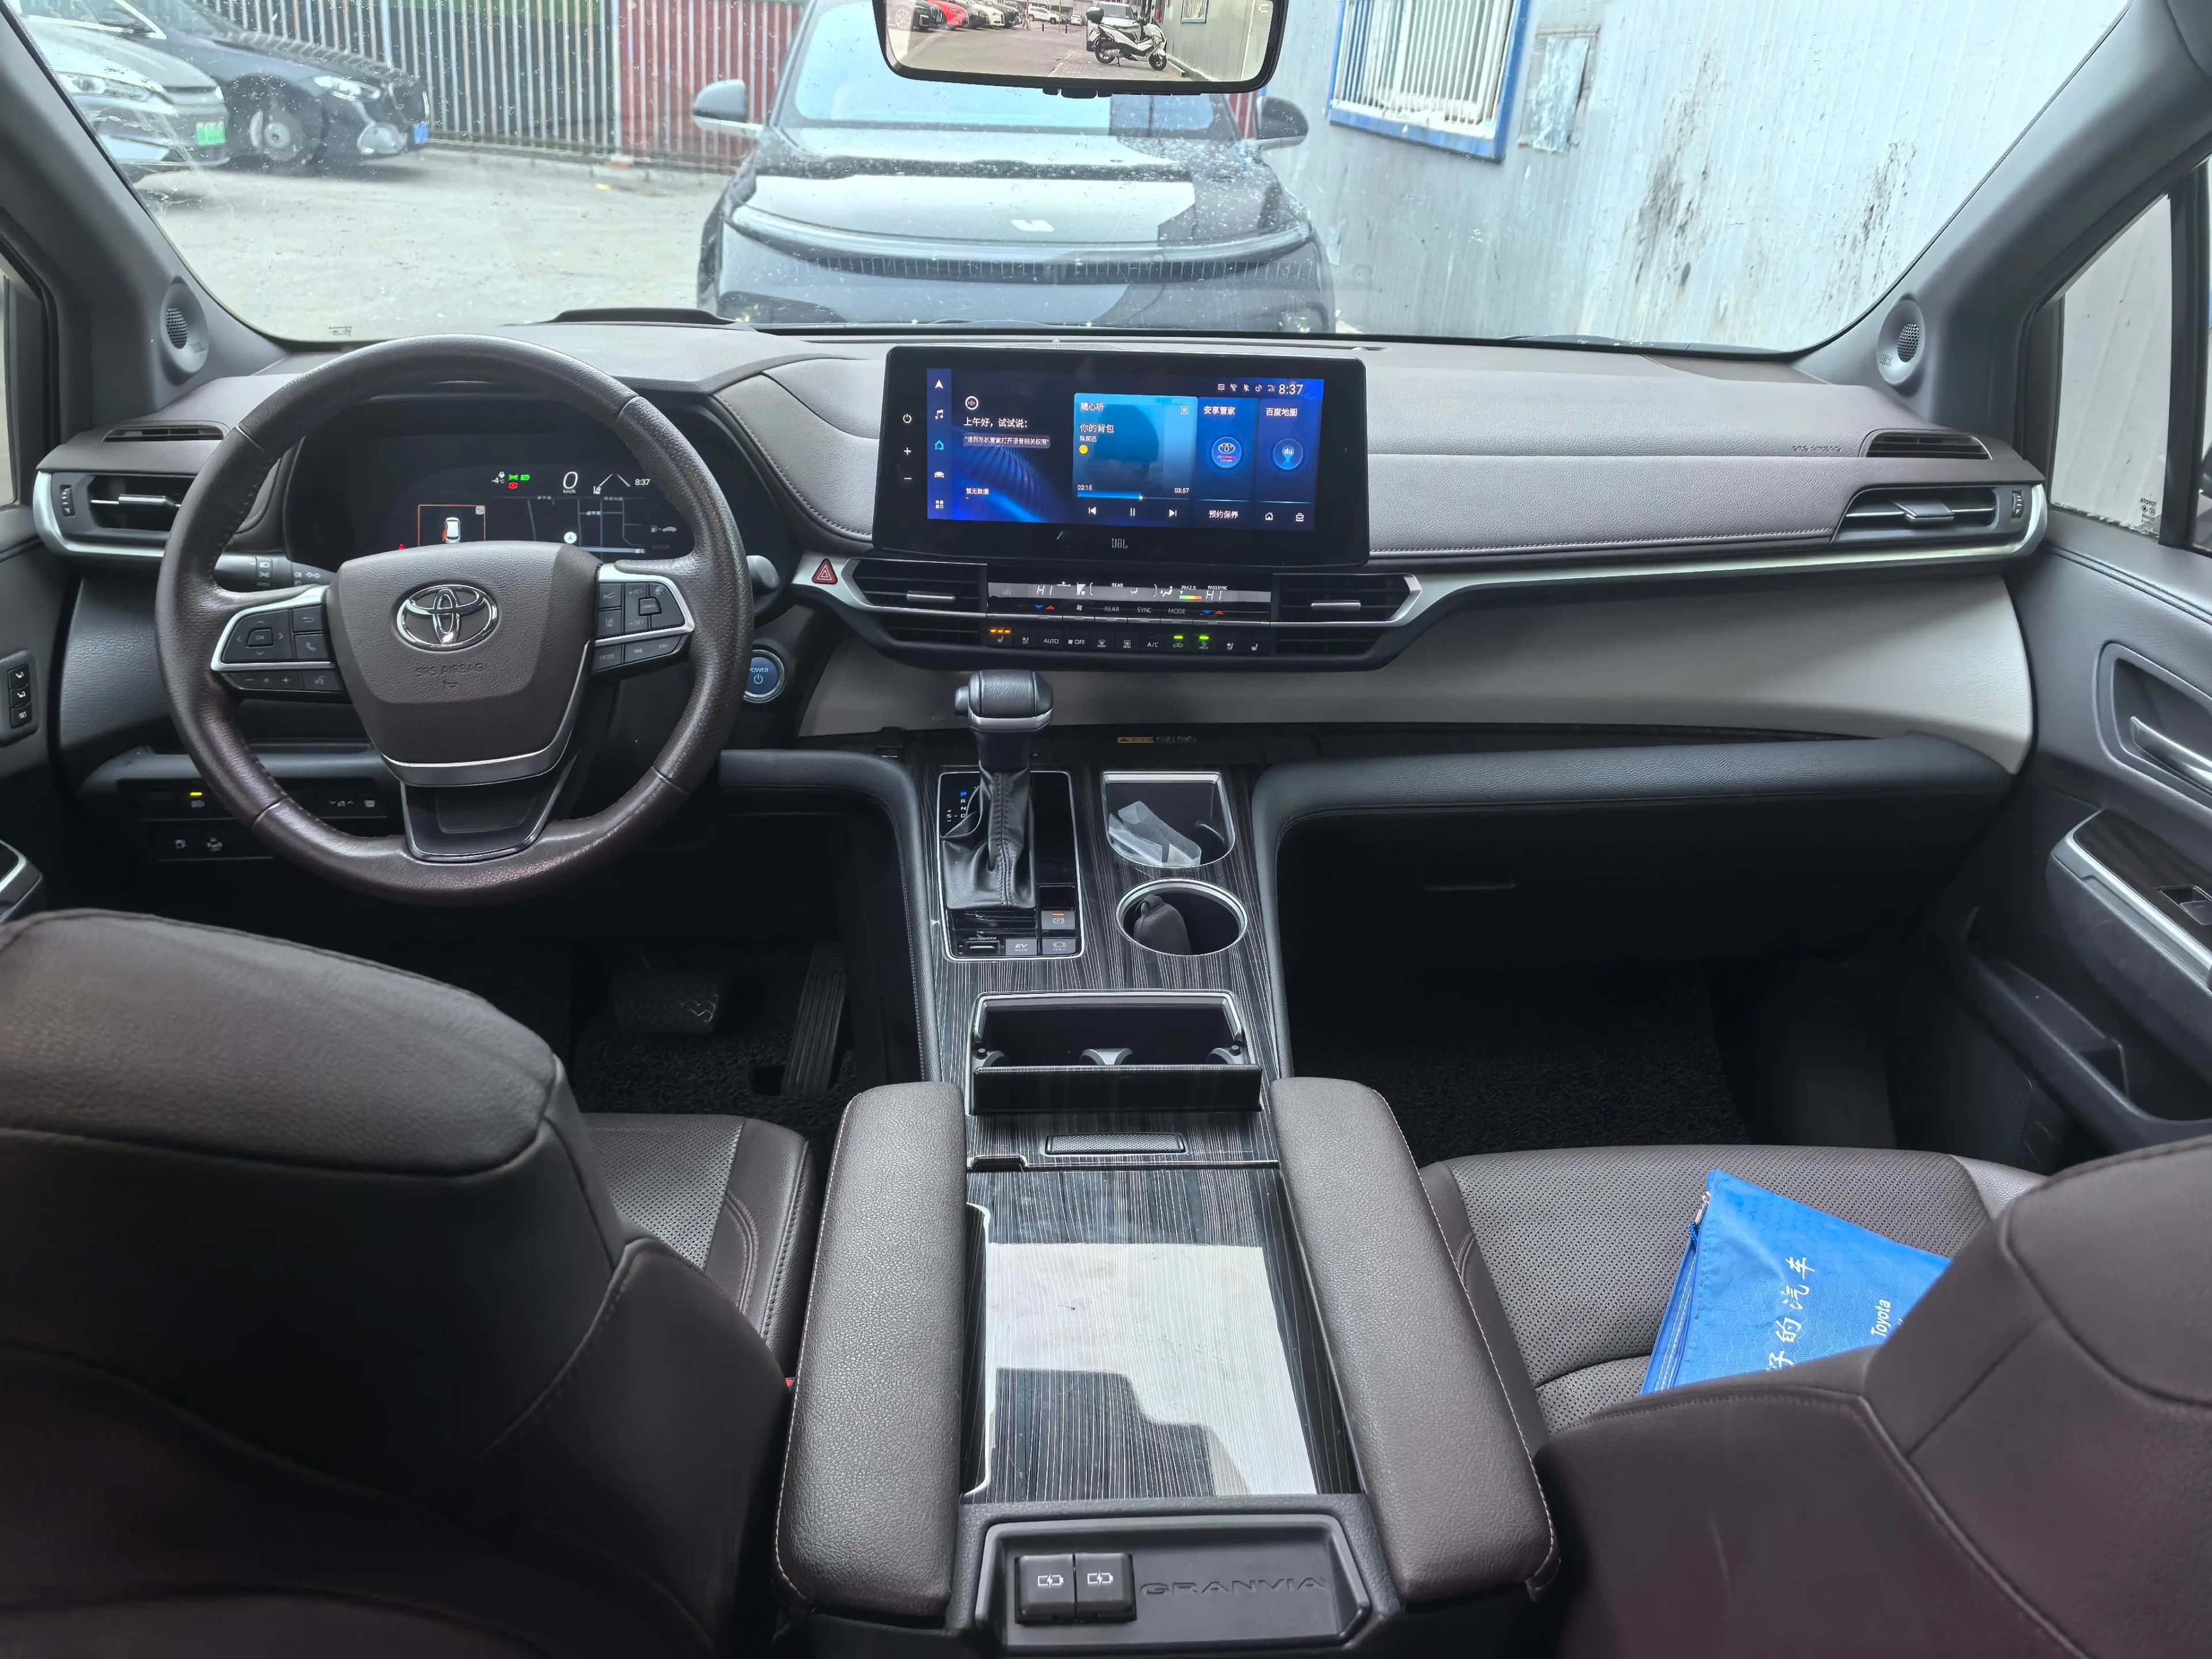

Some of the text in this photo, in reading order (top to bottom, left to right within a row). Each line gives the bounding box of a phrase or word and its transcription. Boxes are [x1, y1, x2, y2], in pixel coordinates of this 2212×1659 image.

[1278, 384, 1304, 395] 8:37
[1080, 402, 1104, 411] 随心听
[1203, 406, 1236, 415] 安享管家
[1266, 407, 1298, 417] 百度地图
[1080, 423, 1114, 433] 你的背包
[562, 471, 578, 489] 0
[1209, 510, 1239, 519] 预约保养
[1111, 538, 1128, 549] JBL
[1870, 1299, 1892, 1338] Toyota
[1139, 1577, 1326, 1594] GRANVIA
